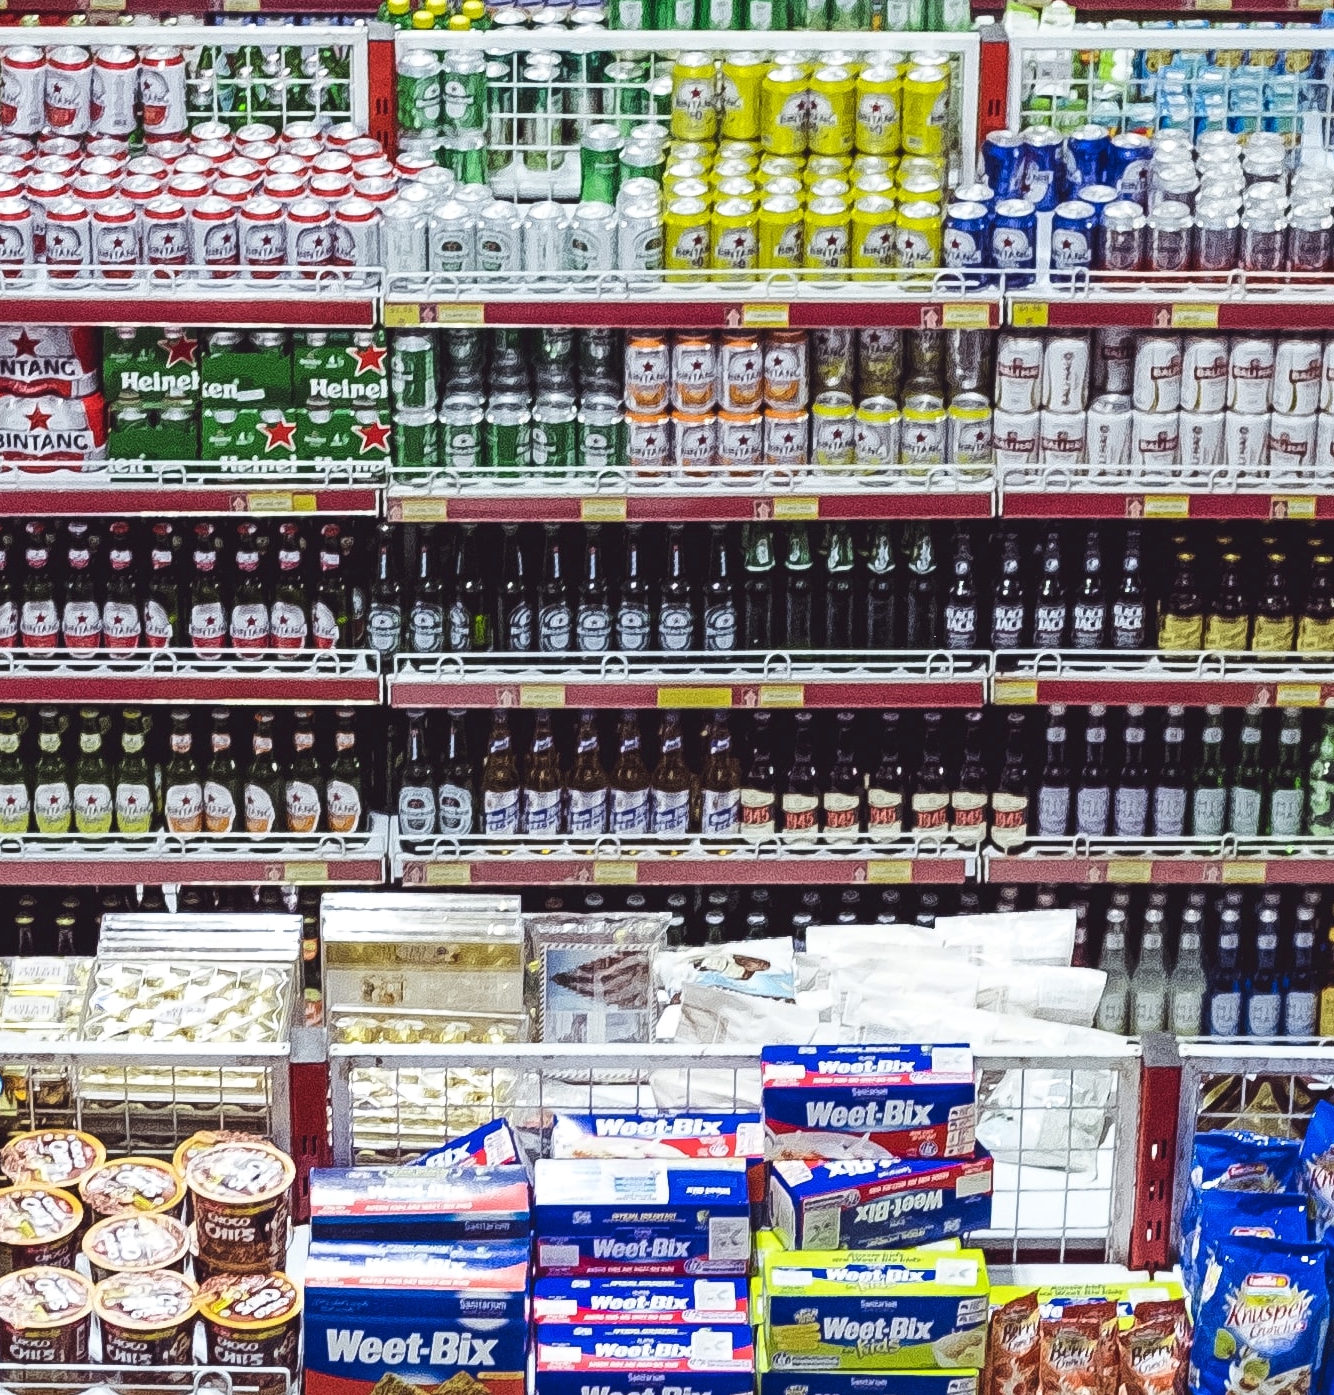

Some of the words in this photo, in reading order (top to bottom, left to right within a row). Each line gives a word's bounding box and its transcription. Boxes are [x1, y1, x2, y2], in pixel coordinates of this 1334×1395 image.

[806, 1100, 934, 1128] Weet-Bix
[207, 1214, 251, 1226] CHOCO
[205, 1224, 256, 1242] CHIPS
[593, 1237, 690, 1260] Weet-Bix
[1228, 1299, 1309, 1327] Knusper
[823, 1316, 934, 1340] Weet-Bix
[1249, 1320, 1294, 1339] Crunch
[10, 1346, 56, 1361] CHIPS
[217, 1338, 260, 1352] CHOCO
[326, 1328, 499, 1366] Weet-Bix
[214, 1350, 264, 1366] CHIPS
